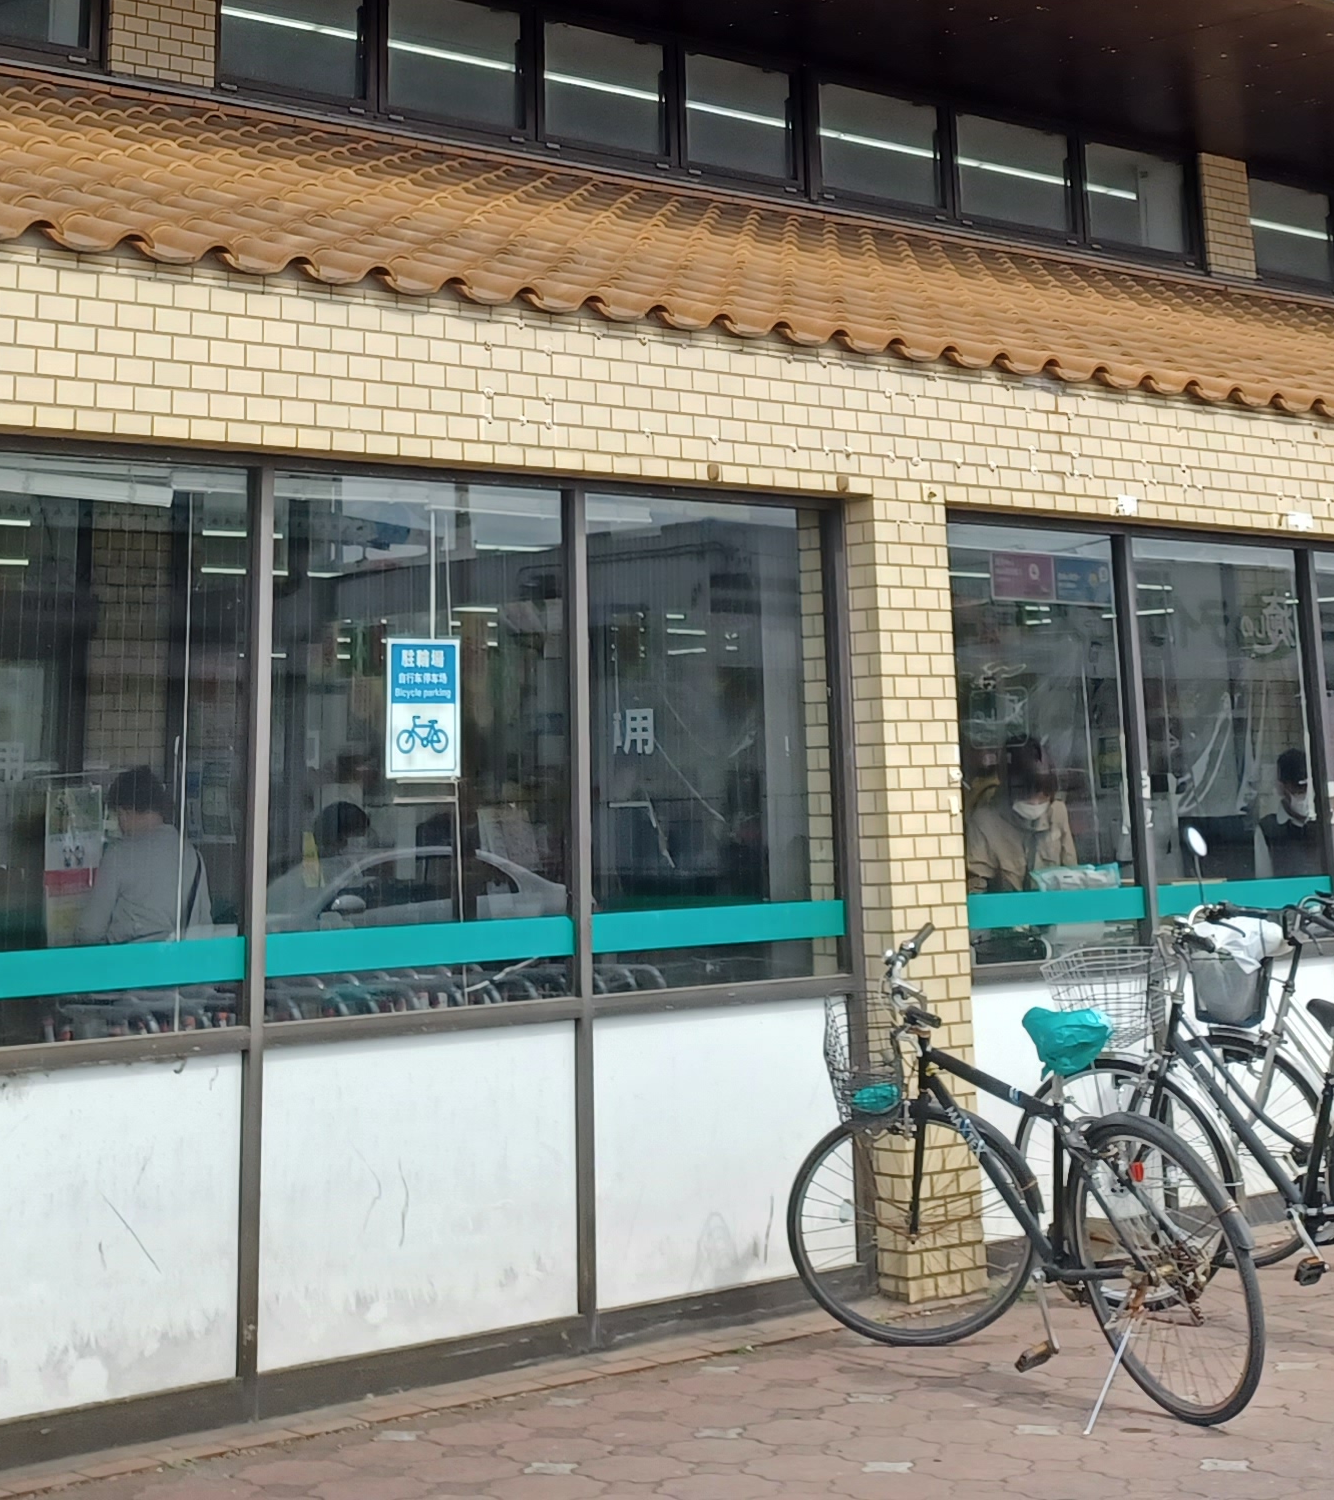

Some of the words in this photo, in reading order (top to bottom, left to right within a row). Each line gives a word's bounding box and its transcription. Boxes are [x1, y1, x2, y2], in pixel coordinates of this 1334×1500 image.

[401, 649, 445, 669] 駐輪場
[394, 687, 423, 699] Bicycle
[423, 688, 452, 699] parking
